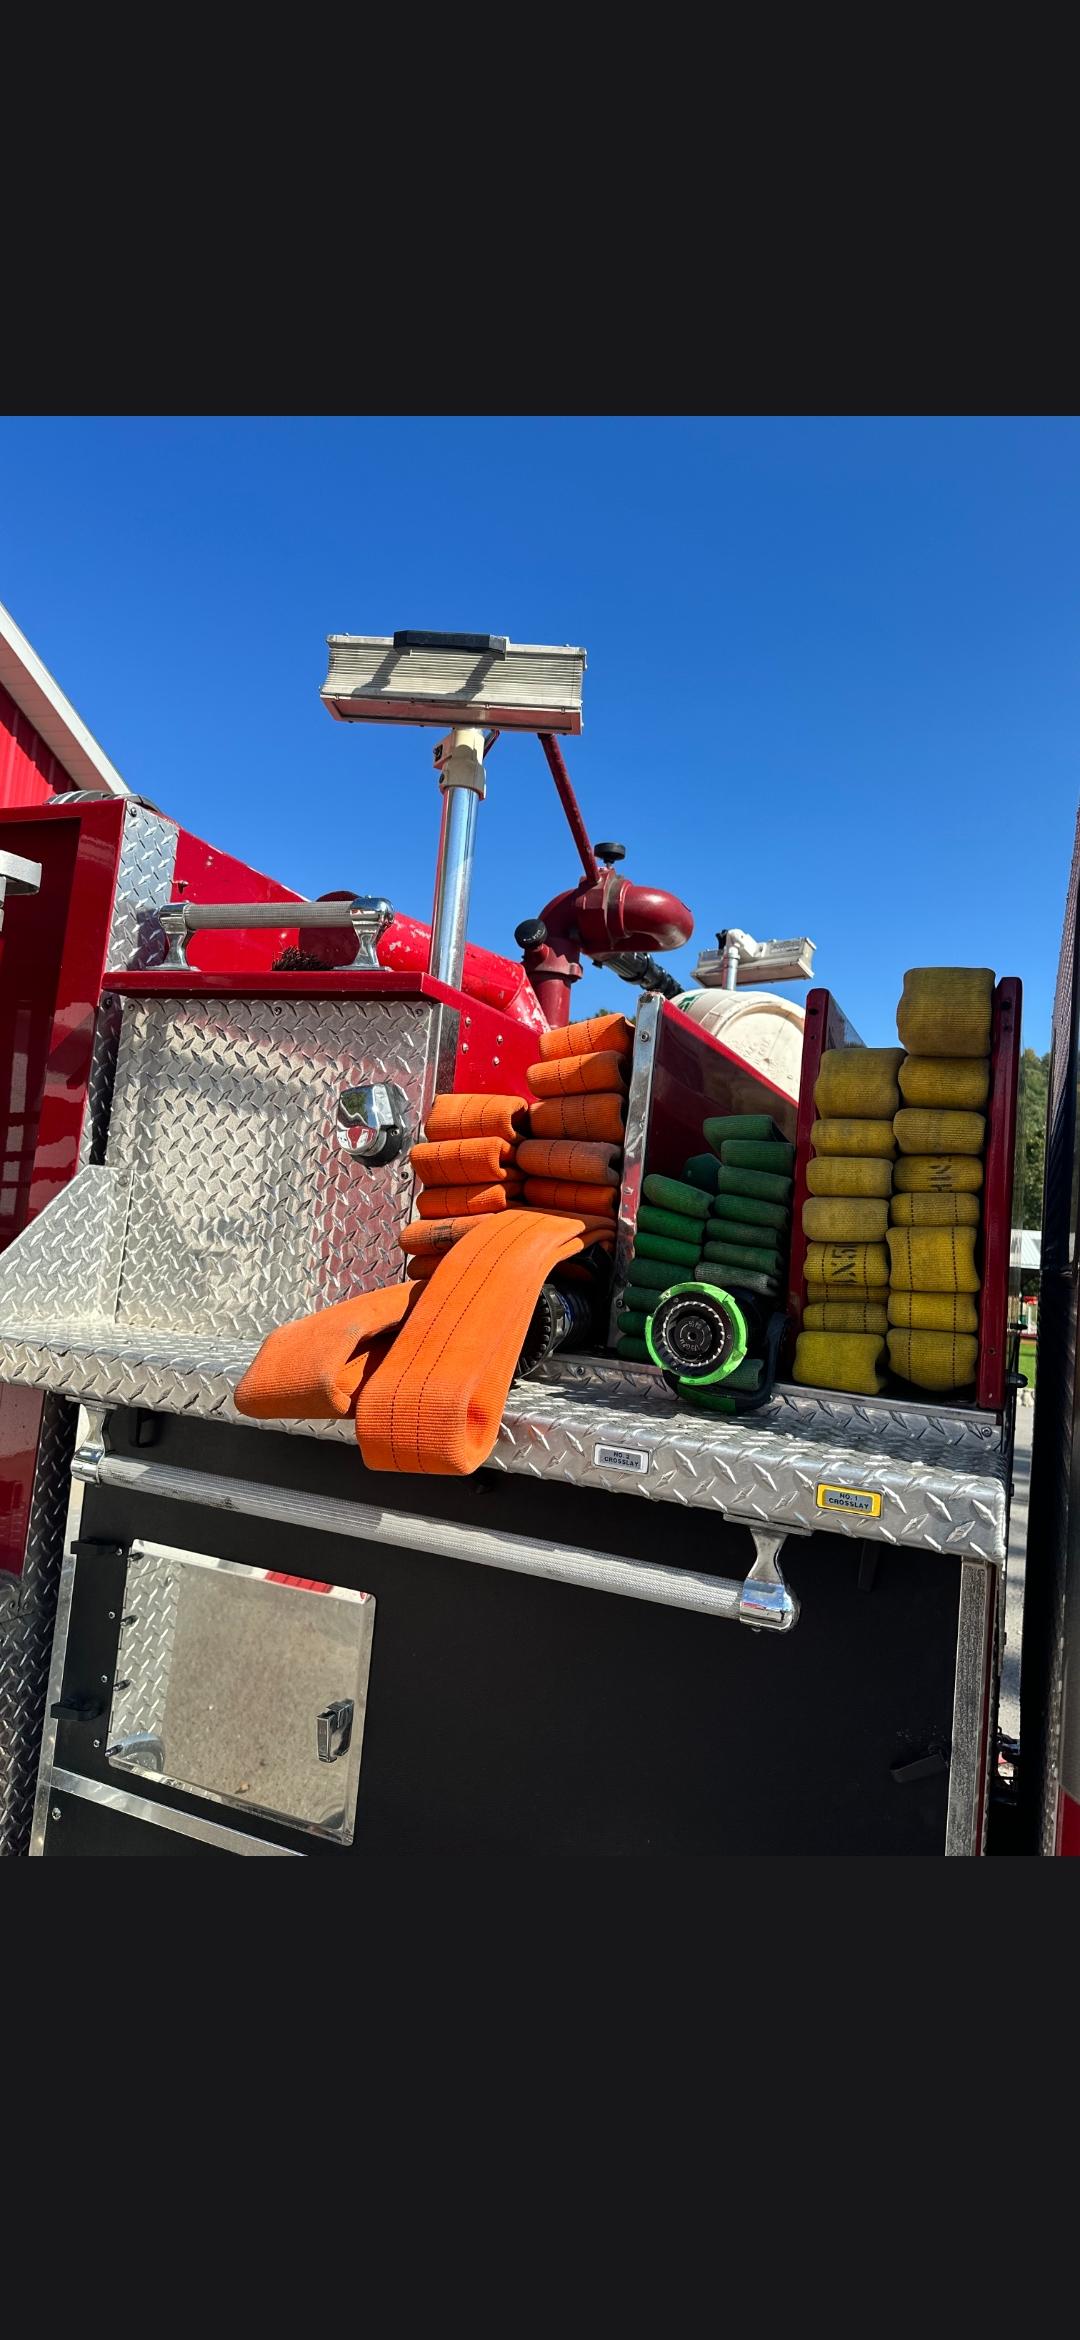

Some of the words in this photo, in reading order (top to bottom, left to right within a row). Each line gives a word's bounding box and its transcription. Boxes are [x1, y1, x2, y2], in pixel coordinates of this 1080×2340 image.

[613, 1451, 625, 1459] NO.
[604, 1456, 639, 1467] CROSSLAY
[839, 1492, 853, 1500] NO.
[828, 1497, 869, 1509] CROSSLAY
